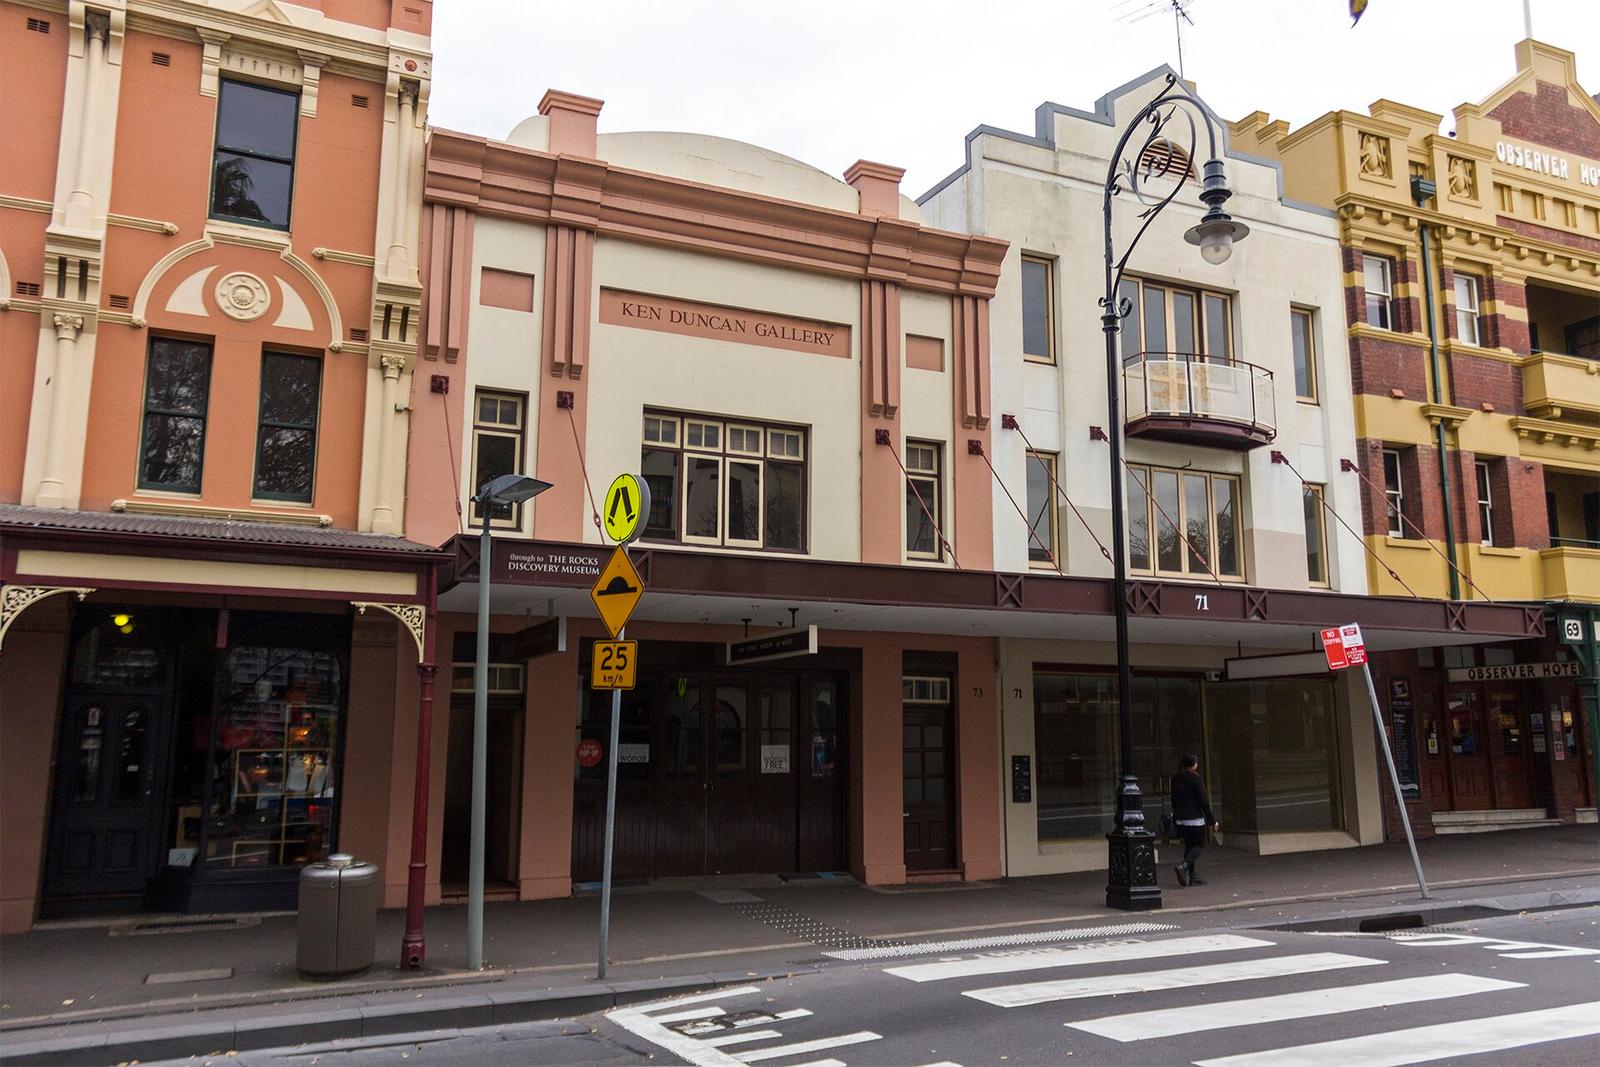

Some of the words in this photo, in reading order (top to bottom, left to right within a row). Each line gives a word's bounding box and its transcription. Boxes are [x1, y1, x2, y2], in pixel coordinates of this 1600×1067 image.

[1496, 142, 1568, 179] OBSERVER
[1580, 163, 1600, 186] HO
[621, 302, 662, 321] KEN
[669, 309, 746, 333] DUNCAN
[755, 322, 834, 346] GALLERY
[510, 553, 536, 563] through
[548, 555, 567, 564] THE
[569, 556, 599, 566] ROCKS
[508, 562, 560, 573] DISCOVERY
[561, 566, 600, 575] MUSEUM
[1194, 594, 1209, 610] 71
[1566, 623, 1580, 637] 69
[601, 646, 627, 671] 25
[602, 674, 624, 685] km/h
[1468, 665, 1536, 680] OBSERVER
[972, 687, 983, 698] 73
[1013, 688, 1023, 699] 71
